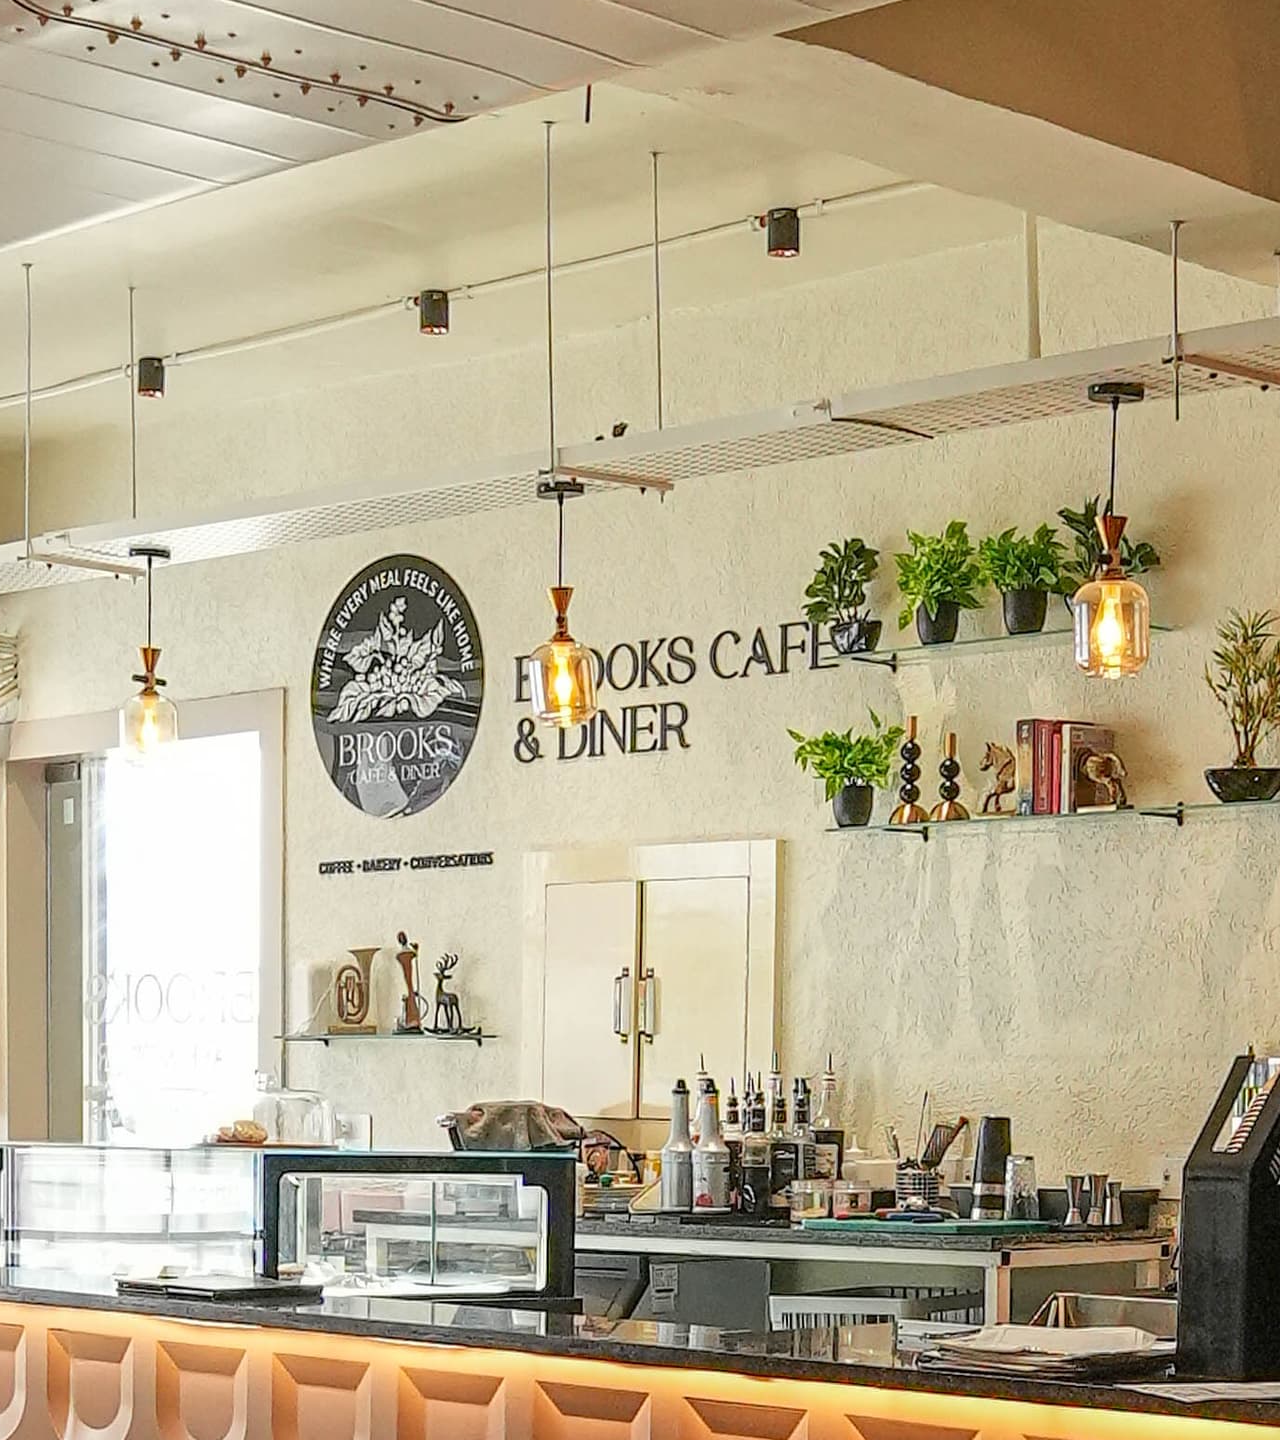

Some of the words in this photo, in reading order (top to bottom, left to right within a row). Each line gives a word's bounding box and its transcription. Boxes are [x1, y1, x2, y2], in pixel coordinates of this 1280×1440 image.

[320, 627, 342, 689] WHERE
[336, 583, 369, 629] EVERY
[370, 568, 400, 594] MEAL
[404, 569, 439, 597] FEELS
[436, 588, 461, 624] LIKE
[453, 618, 474, 673] HOME
[339, 725, 453, 767] BROOKS
[513, 717, 544, 764] &
[557, 701, 691, 761] DINER
[388, 766, 397, 783] &
[401, 762, 441, 781] DINER
